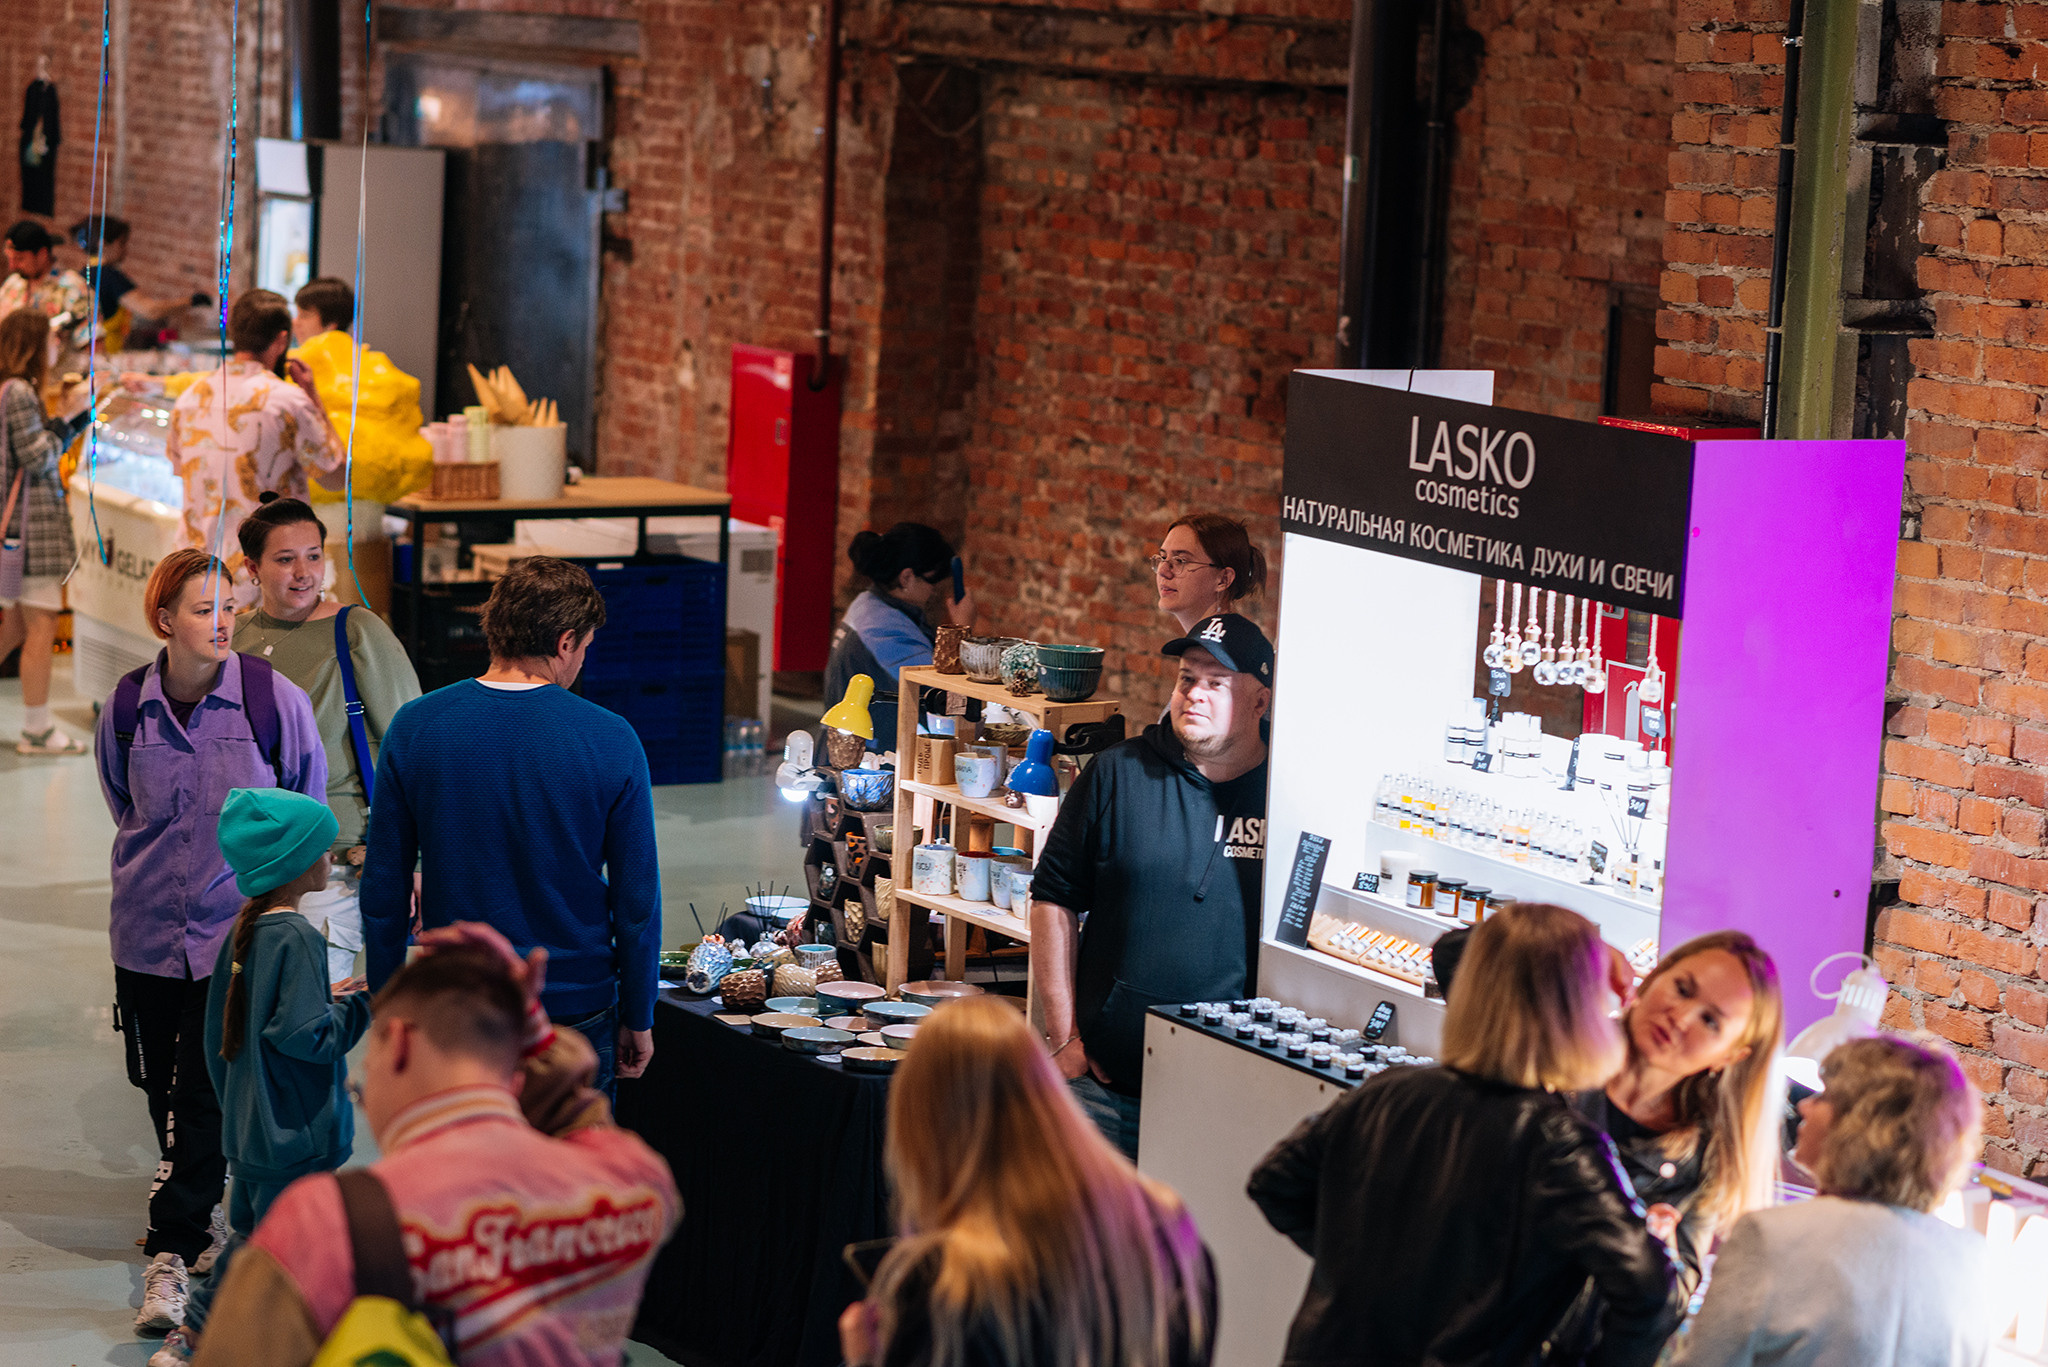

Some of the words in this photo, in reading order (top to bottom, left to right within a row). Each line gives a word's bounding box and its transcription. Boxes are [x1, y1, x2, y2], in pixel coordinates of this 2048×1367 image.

[1408, 415, 1536, 489] LASKO
[1415, 478, 1520, 519] cosmetics
[1282, 495, 1405, 544] НАТУРАЛЬНАЯ
[1409, 522, 1524, 571] КОСМЕТИКА
[1530, 546, 1585, 579] ДУХИ
[1589, 560, 1605, 585] И
[1610, 562, 1675, 600] СВЕЧИ
[1200, 617, 1227, 643] LA
